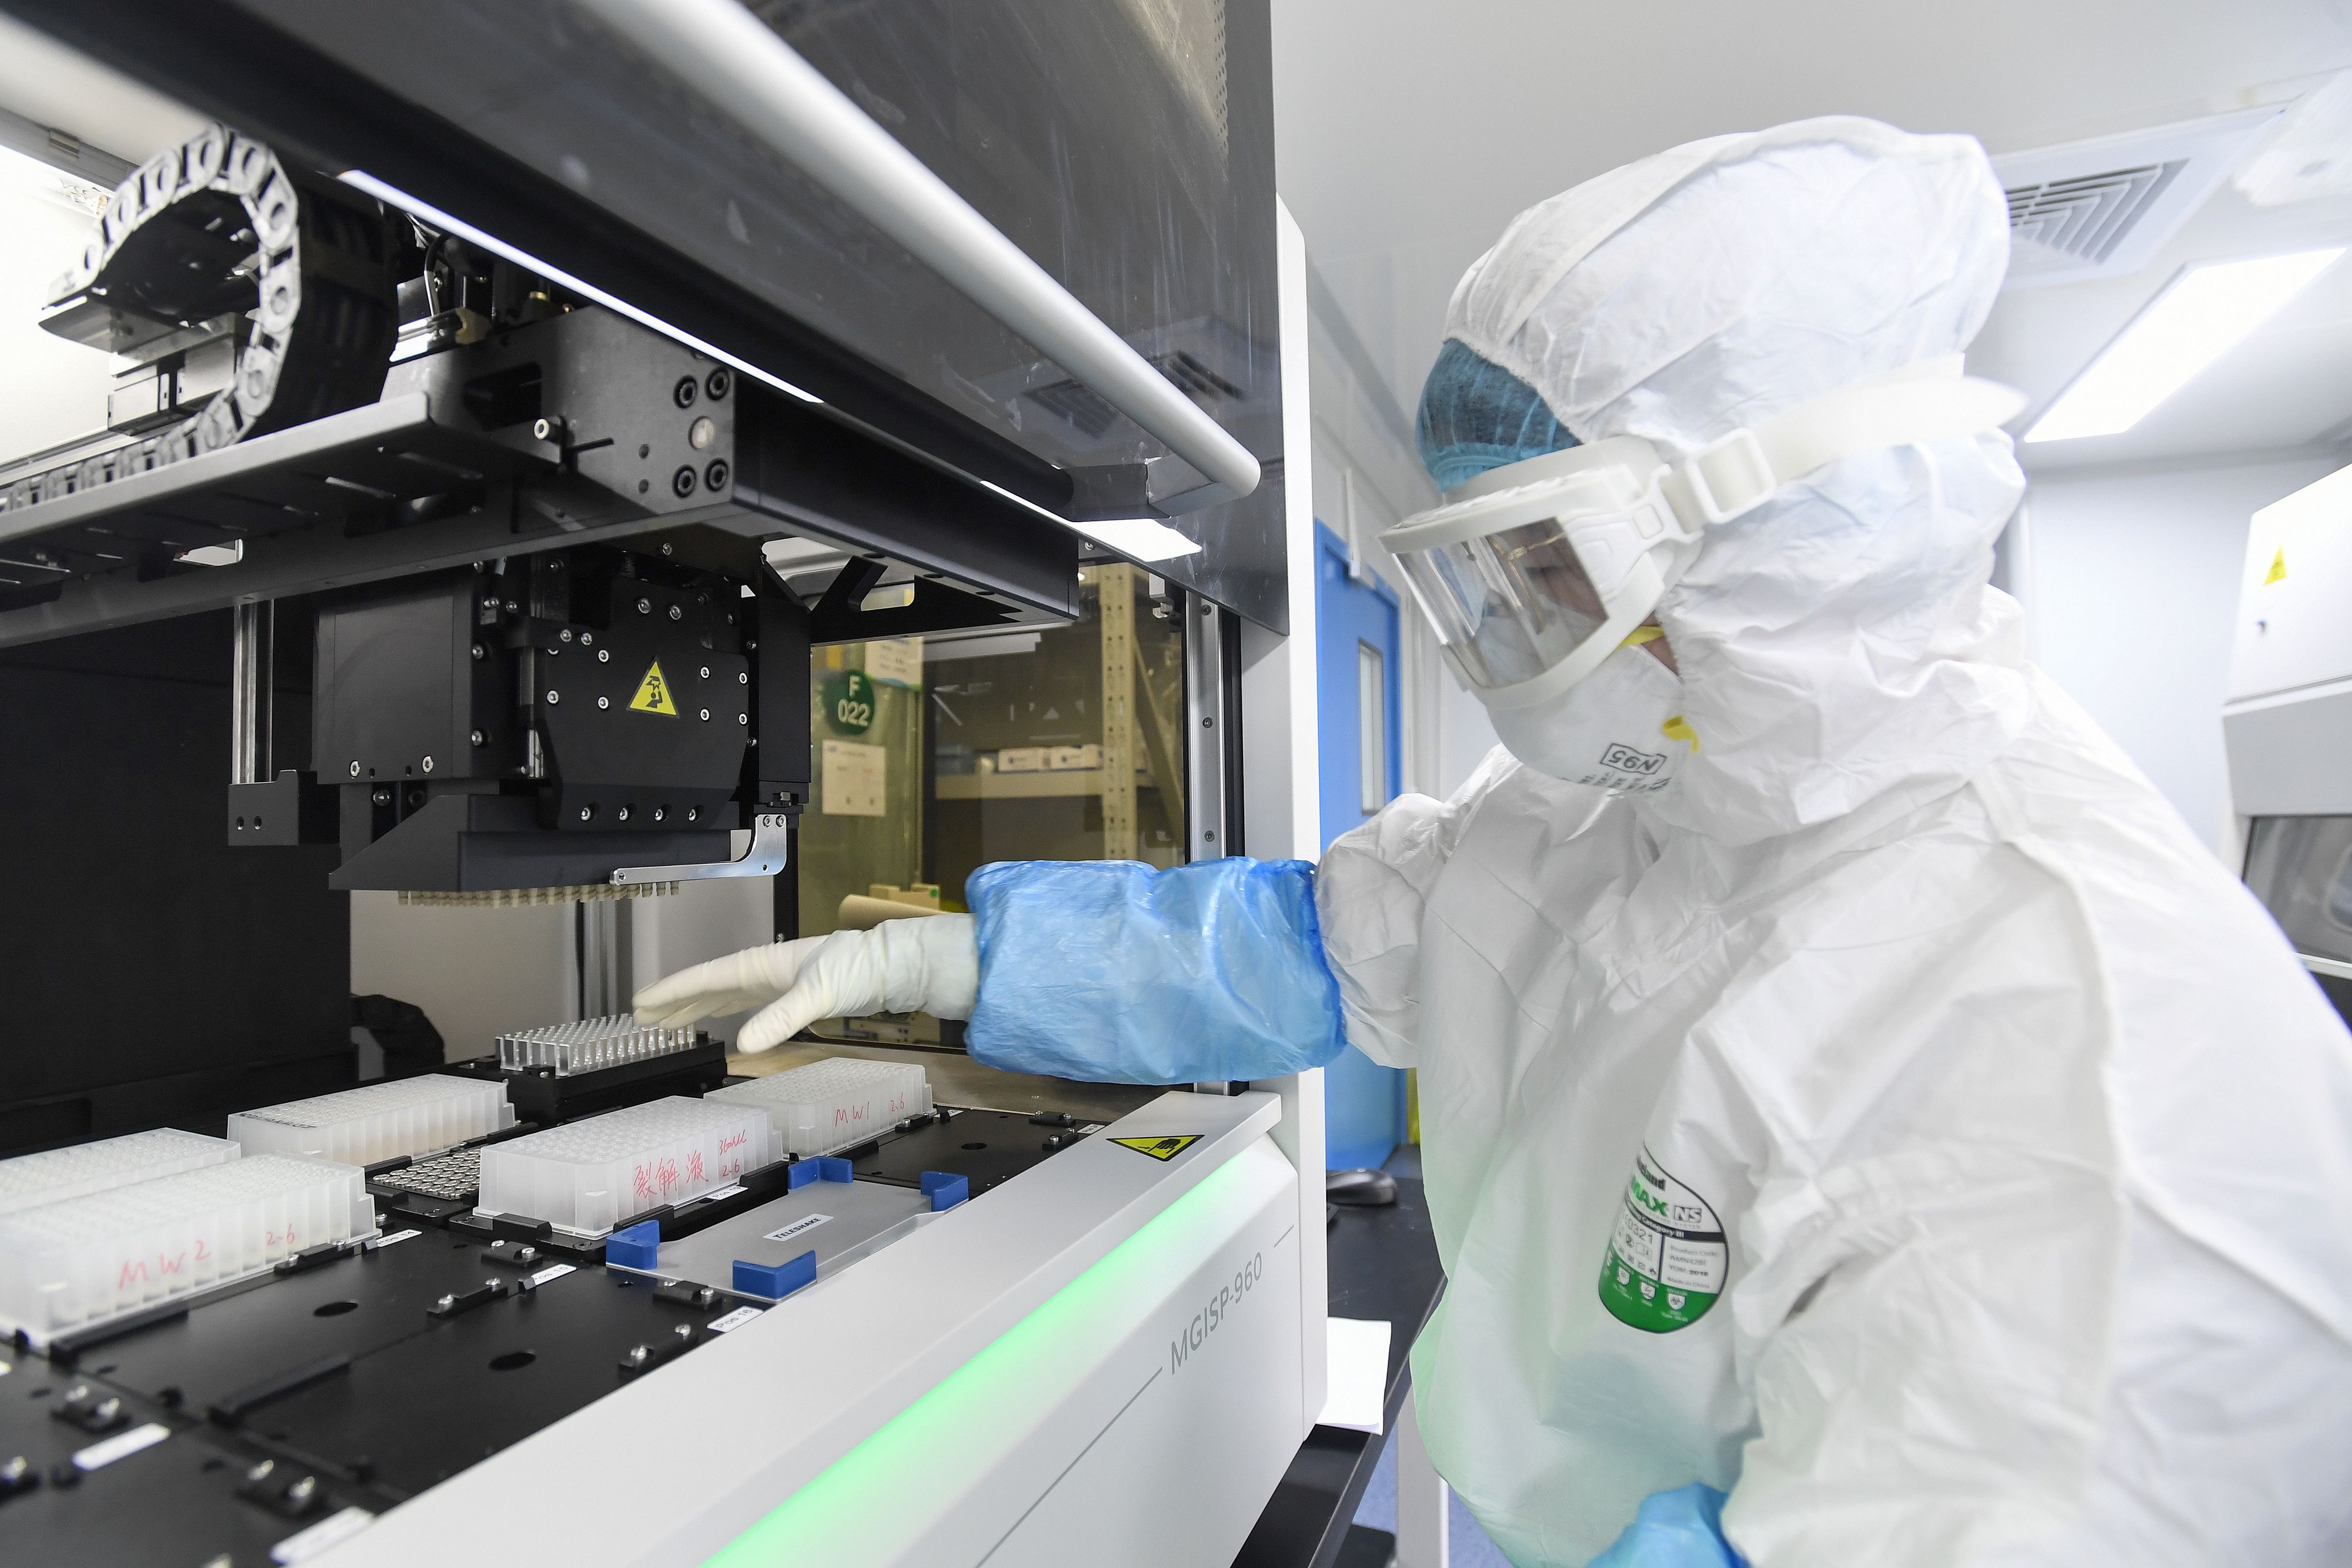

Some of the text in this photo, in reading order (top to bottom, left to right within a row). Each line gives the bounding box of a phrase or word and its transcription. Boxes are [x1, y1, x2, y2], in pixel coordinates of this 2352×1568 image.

[849, 675, 861, 697] F
[837, 698, 871, 727] 022
[1608, 750, 1659, 771] N95
[1674, 1206, 1702, 1223] NS
[773, 1218, 822, 1239] TELESHAKE
[716, 1317, 739, 1329] Pos
[1171, 1252, 1262, 1376] MGISP-960
